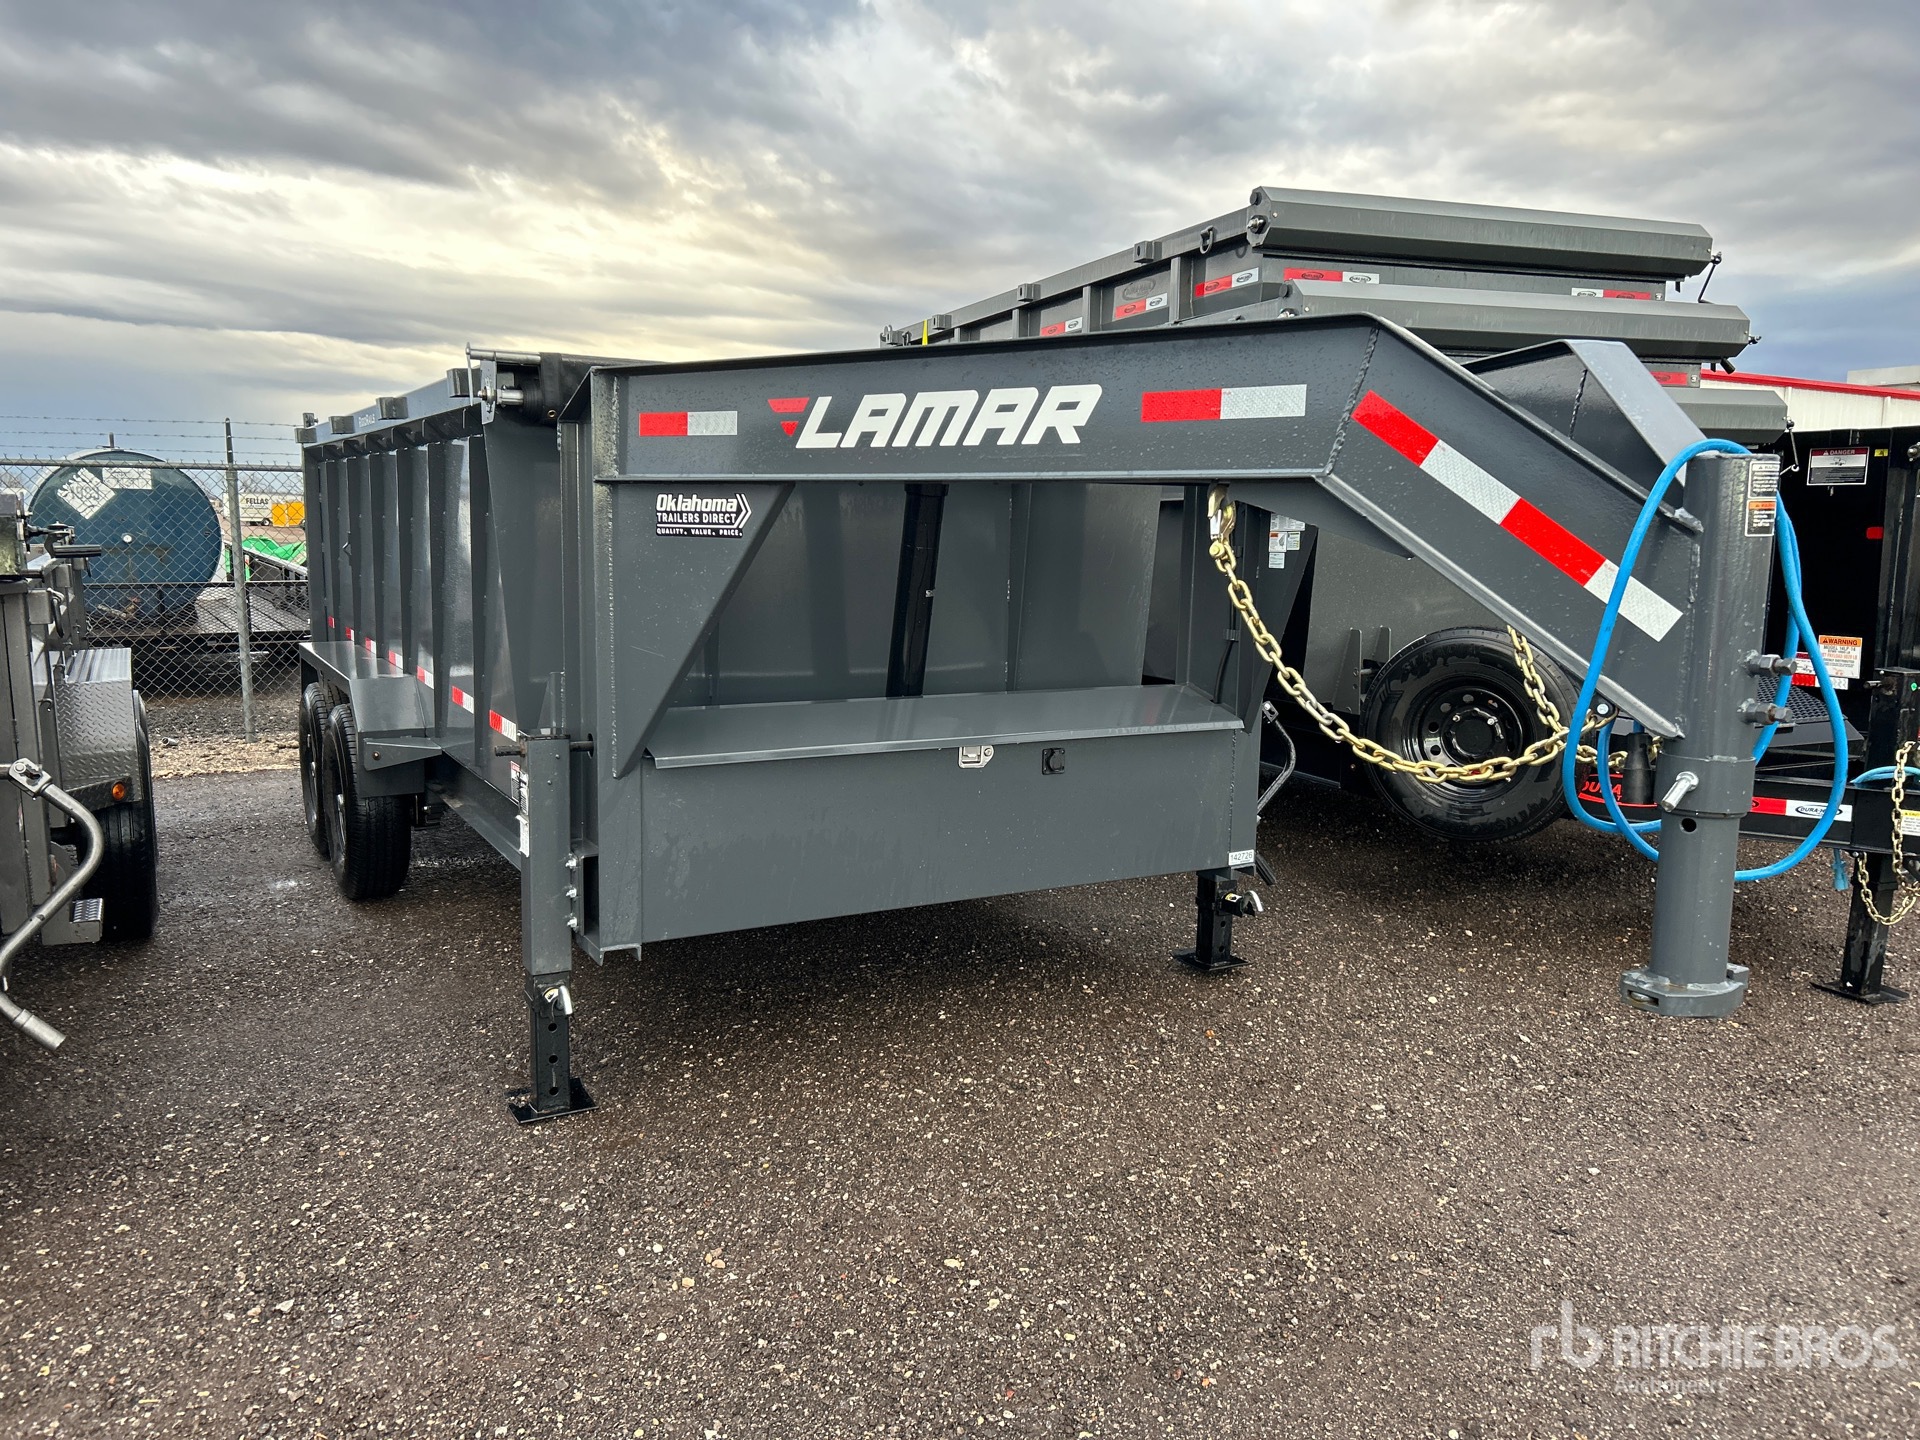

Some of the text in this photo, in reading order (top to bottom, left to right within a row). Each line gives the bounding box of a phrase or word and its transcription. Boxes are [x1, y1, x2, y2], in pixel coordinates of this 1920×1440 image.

[796, 384, 1102, 449] LAMAR
[656, 494, 738, 512] Oklahoma
[656, 513, 736, 524] TRAILERS DIRECT
[1828, 637, 1858, 646] WARNING
